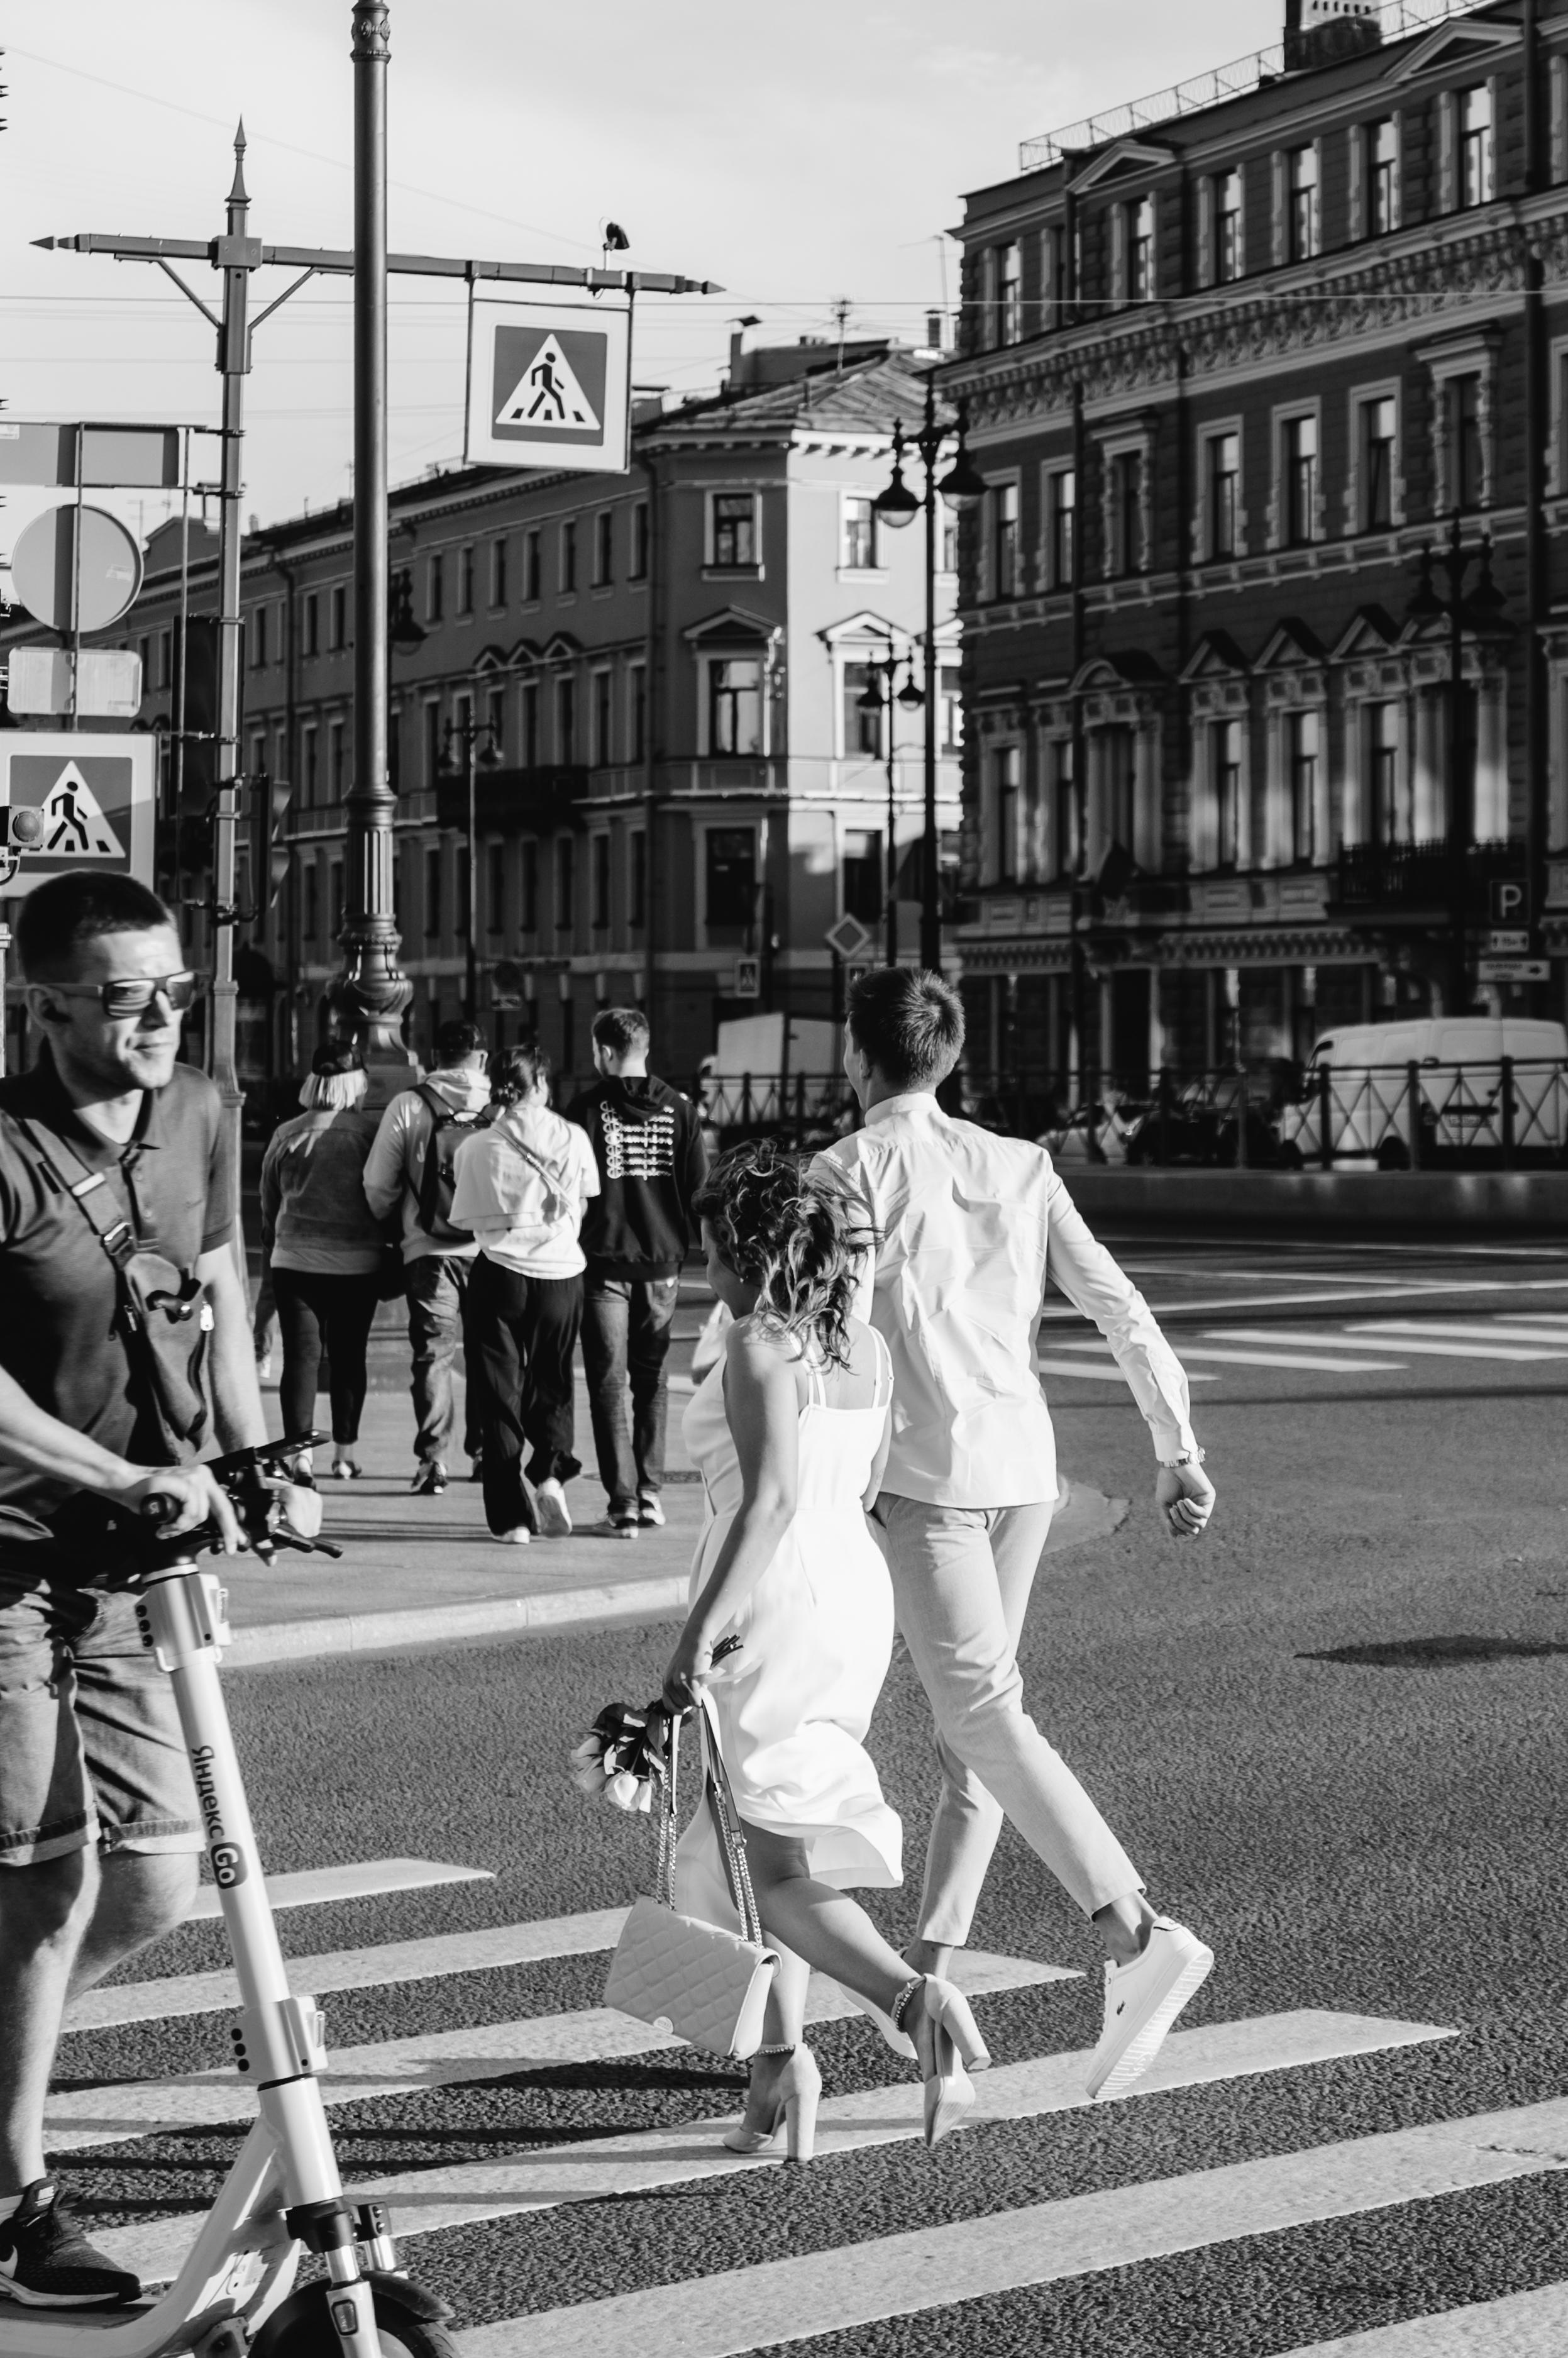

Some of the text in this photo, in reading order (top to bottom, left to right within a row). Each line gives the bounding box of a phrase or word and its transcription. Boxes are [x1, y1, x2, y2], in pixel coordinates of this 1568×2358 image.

[1501, 883, 1522, 919] P
[191, 1745, 239, 1885] Яндекс Go
